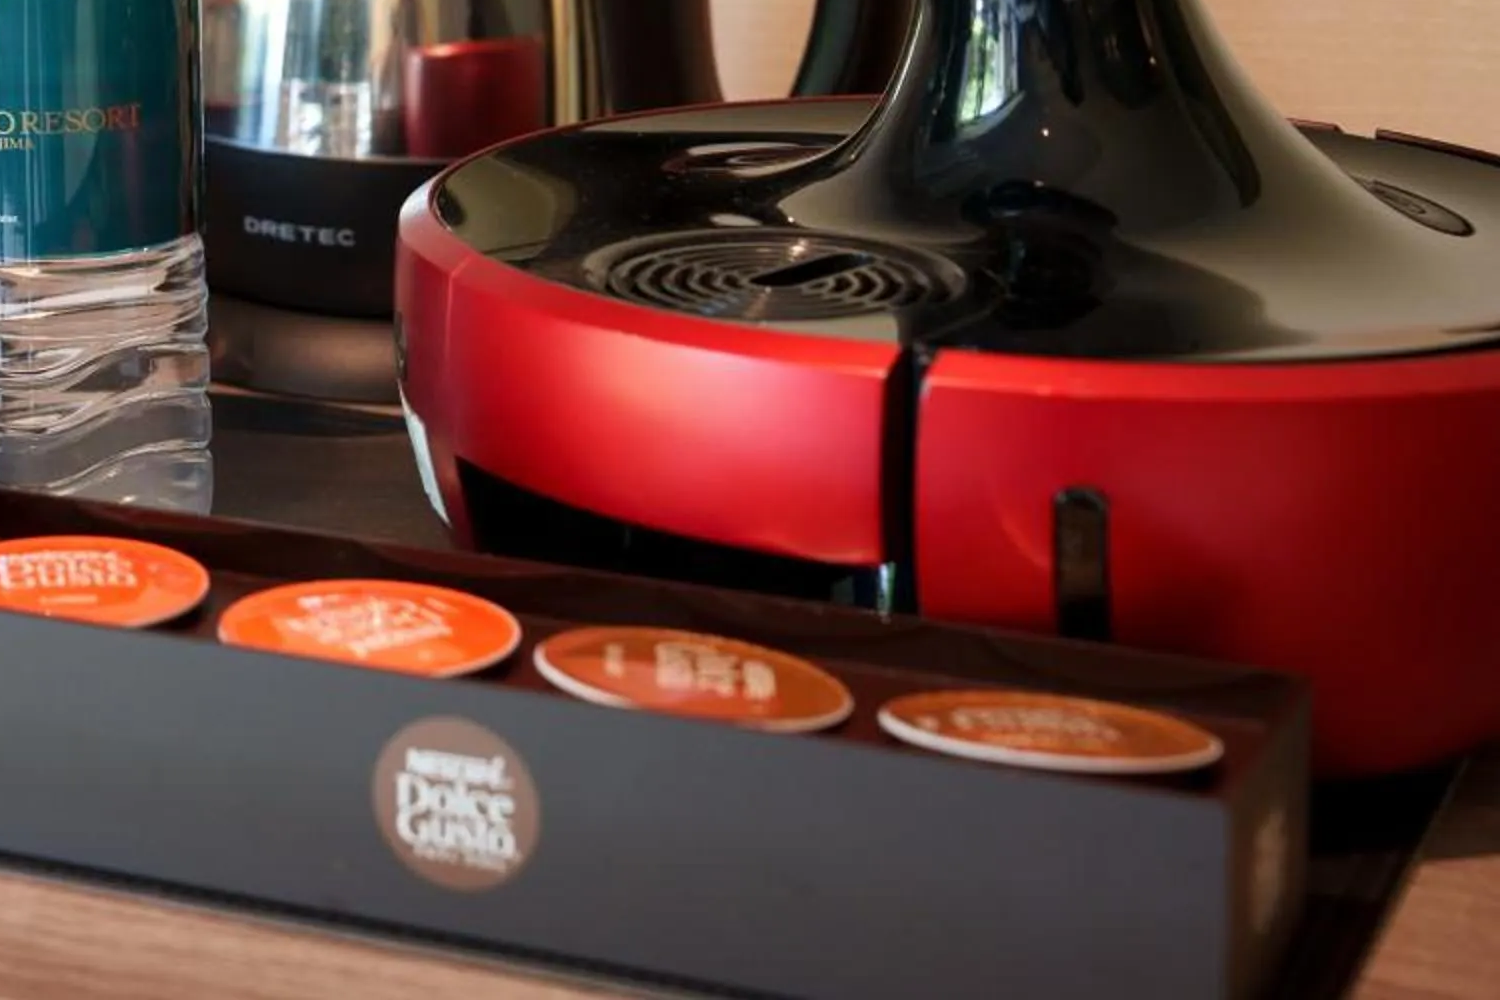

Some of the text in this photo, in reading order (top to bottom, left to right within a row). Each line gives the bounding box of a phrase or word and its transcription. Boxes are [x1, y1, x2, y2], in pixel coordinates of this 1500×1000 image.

[20, 103, 141, 135] RESORT
[243, 214, 357, 248] DRETEC
[396, 771, 515, 822] Dolce
[396, 812, 517, 860] Gusto
